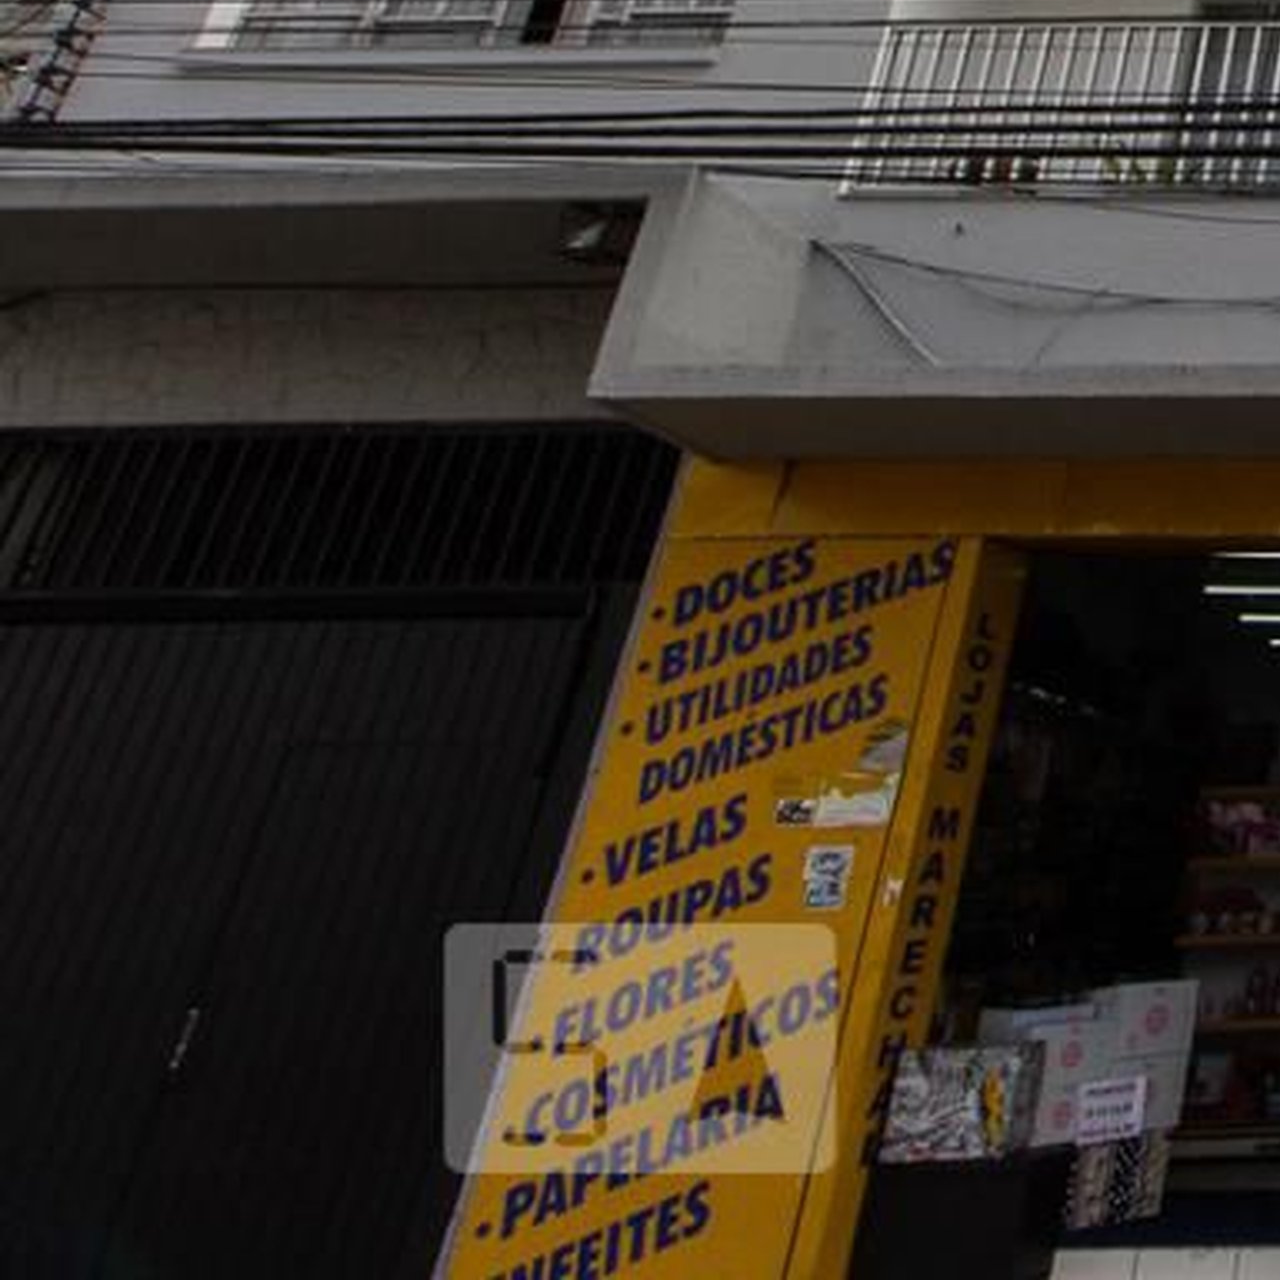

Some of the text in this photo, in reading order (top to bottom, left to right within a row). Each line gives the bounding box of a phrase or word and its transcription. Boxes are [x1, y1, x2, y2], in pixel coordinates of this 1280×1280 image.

[658, 540, 957, 684] BIJOUTERIAS
[673, 538, 815, 628] DOCES
[646, 624, 873, 744] UTILIDADES
[944, 610, 995, 773] LOJAS
[605, 794, 748, 886] VELAS
[573, 853, 772, 972] ROUPAS
[552, 940, 735, 1057] FLORES
[501, 1072, 785, 1239] PAPELARIA
